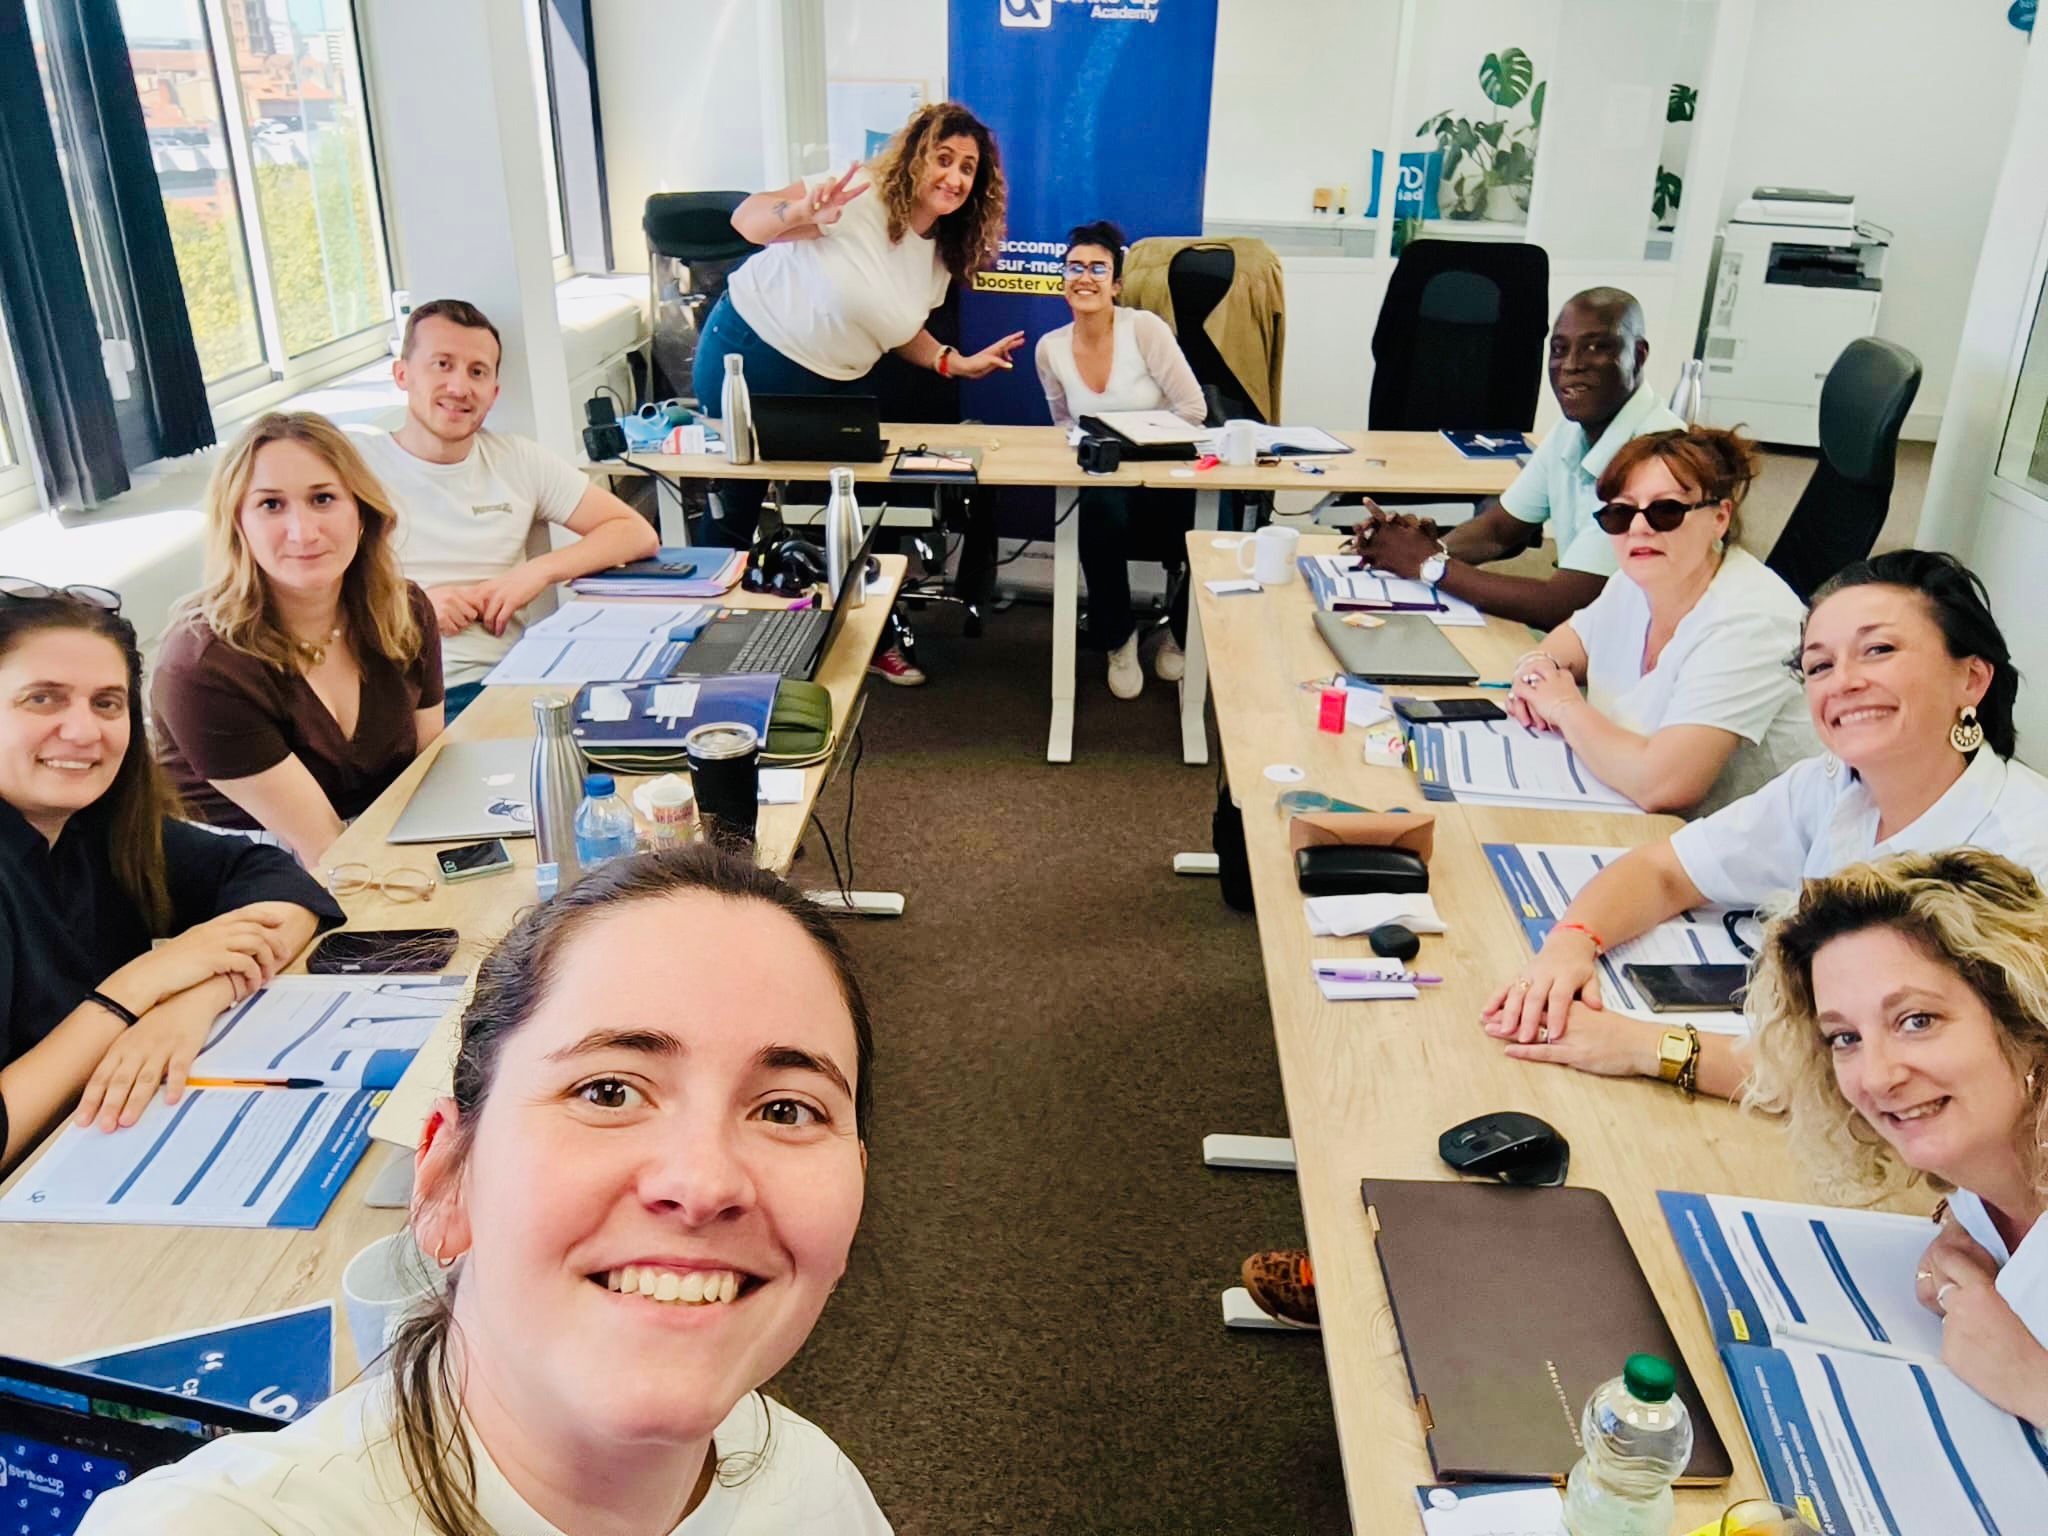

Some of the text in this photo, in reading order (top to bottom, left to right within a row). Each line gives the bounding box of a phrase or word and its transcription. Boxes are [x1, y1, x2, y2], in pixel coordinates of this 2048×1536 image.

[1090, 5, 1159, 23] Academy
[997, 241, 1069, 258] accomp
[976, 273, 1041, 291] booster
